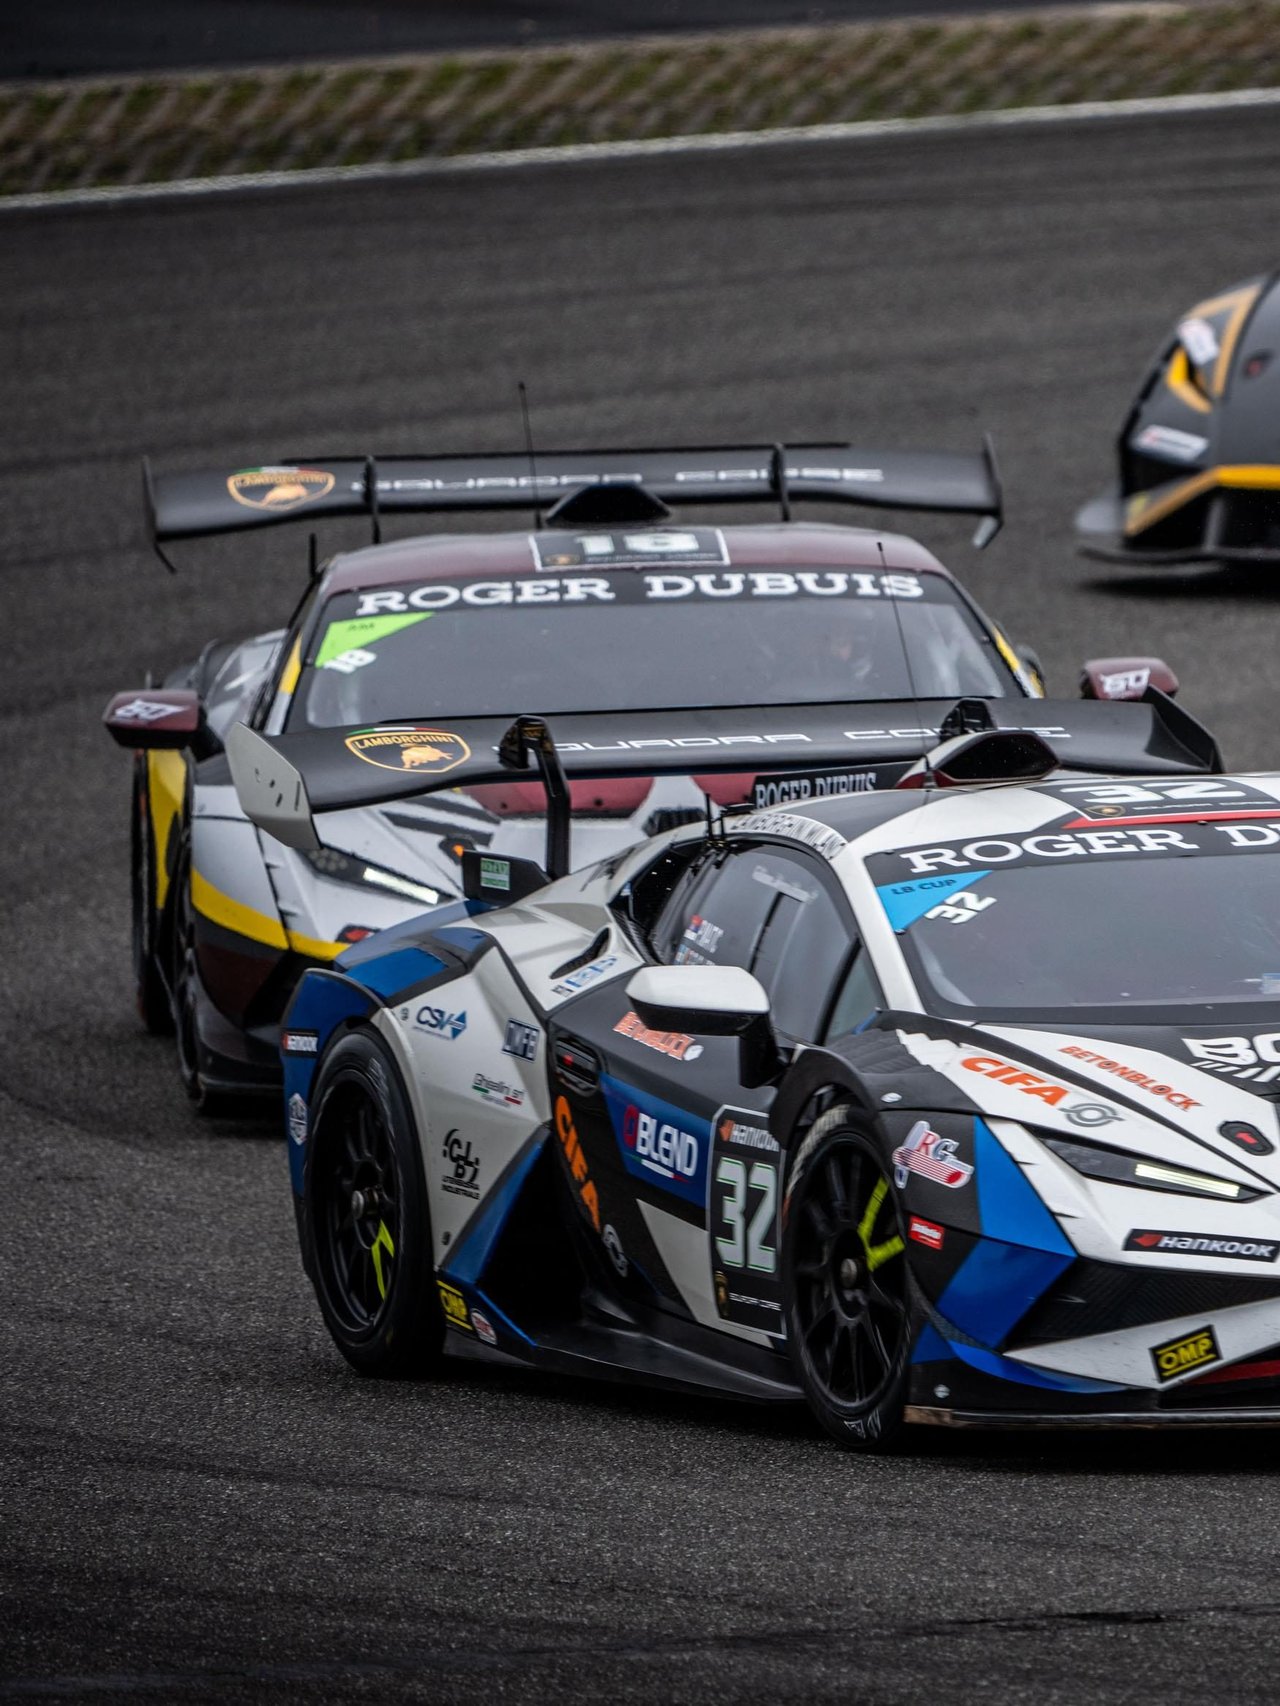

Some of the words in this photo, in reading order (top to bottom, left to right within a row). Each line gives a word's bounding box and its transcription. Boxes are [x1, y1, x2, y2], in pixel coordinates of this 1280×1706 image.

[356, 578, 616, 616] ROGER
[645, 572, 924, 599] DUBUIS
[355, 735, 455, 749] LAMBORGHINI
[491, 733, 813, 752] QUADRA
[844, 727, 1072, 740] COE
[755, 779, 812, 809] ROGER
[815, 772, 877, 797] DUBUIS
[1060, 781, 1246, 804] 32
[899, 828, 1204, 873] ROGER
[890, 885, 915, 895] LB
[918, 879, 957, 890] CUP
[923, 891, 998, 924] 32
[960, 1056, 1071, 1107] CIFA
[1057, 1045, 1204, 1112] BETONBLOCK
[554, 1095, 600, 1232] CIFA
[635, 1112, 698, 1177] BLEND
[715, 1157, 776, 1274] 32
[1158, 1338, 1213, 1370] OMP
